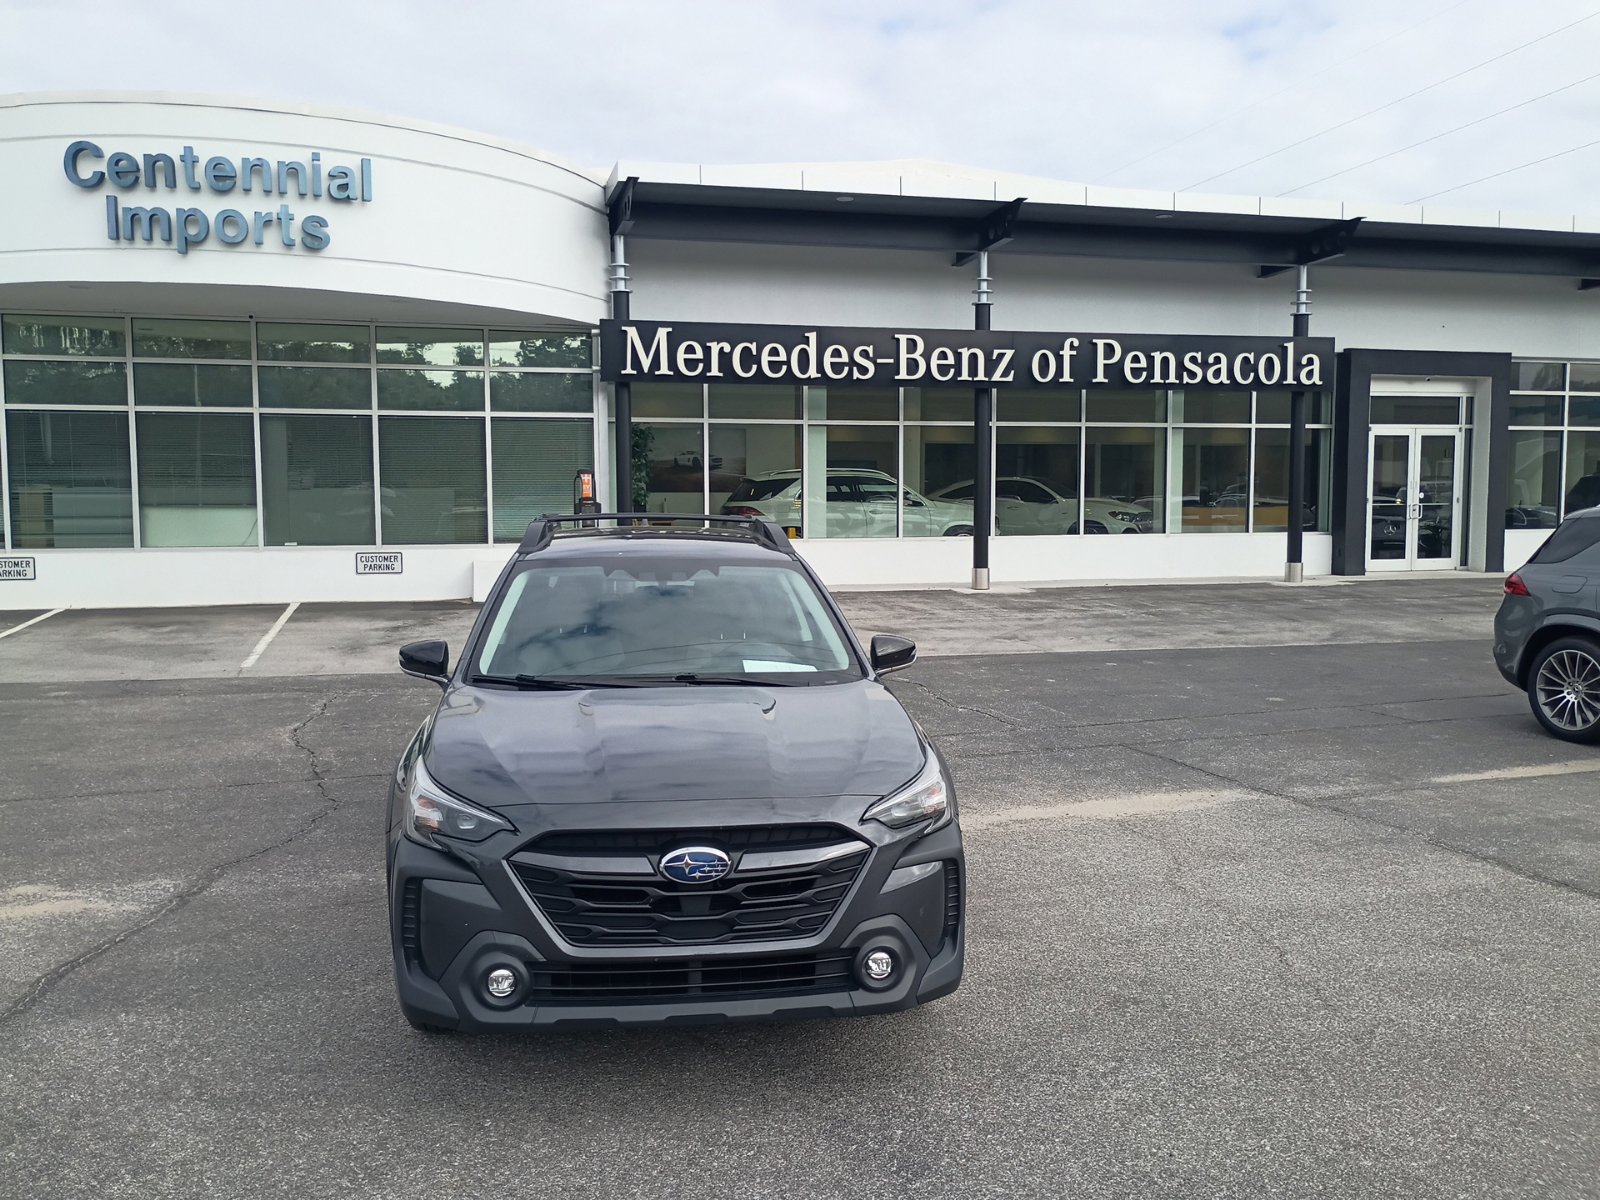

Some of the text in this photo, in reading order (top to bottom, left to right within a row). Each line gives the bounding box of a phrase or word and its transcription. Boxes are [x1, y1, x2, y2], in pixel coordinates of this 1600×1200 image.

[63, 140, 373, 202] Centennial
[105, 195, 331, 255] Imports
[621, 326, 1323, 386] Mercedes-Benz of Pensacola
[360, 555, 399, 563] CUSTOMER
[363, 563, 396, 571] PARKING
